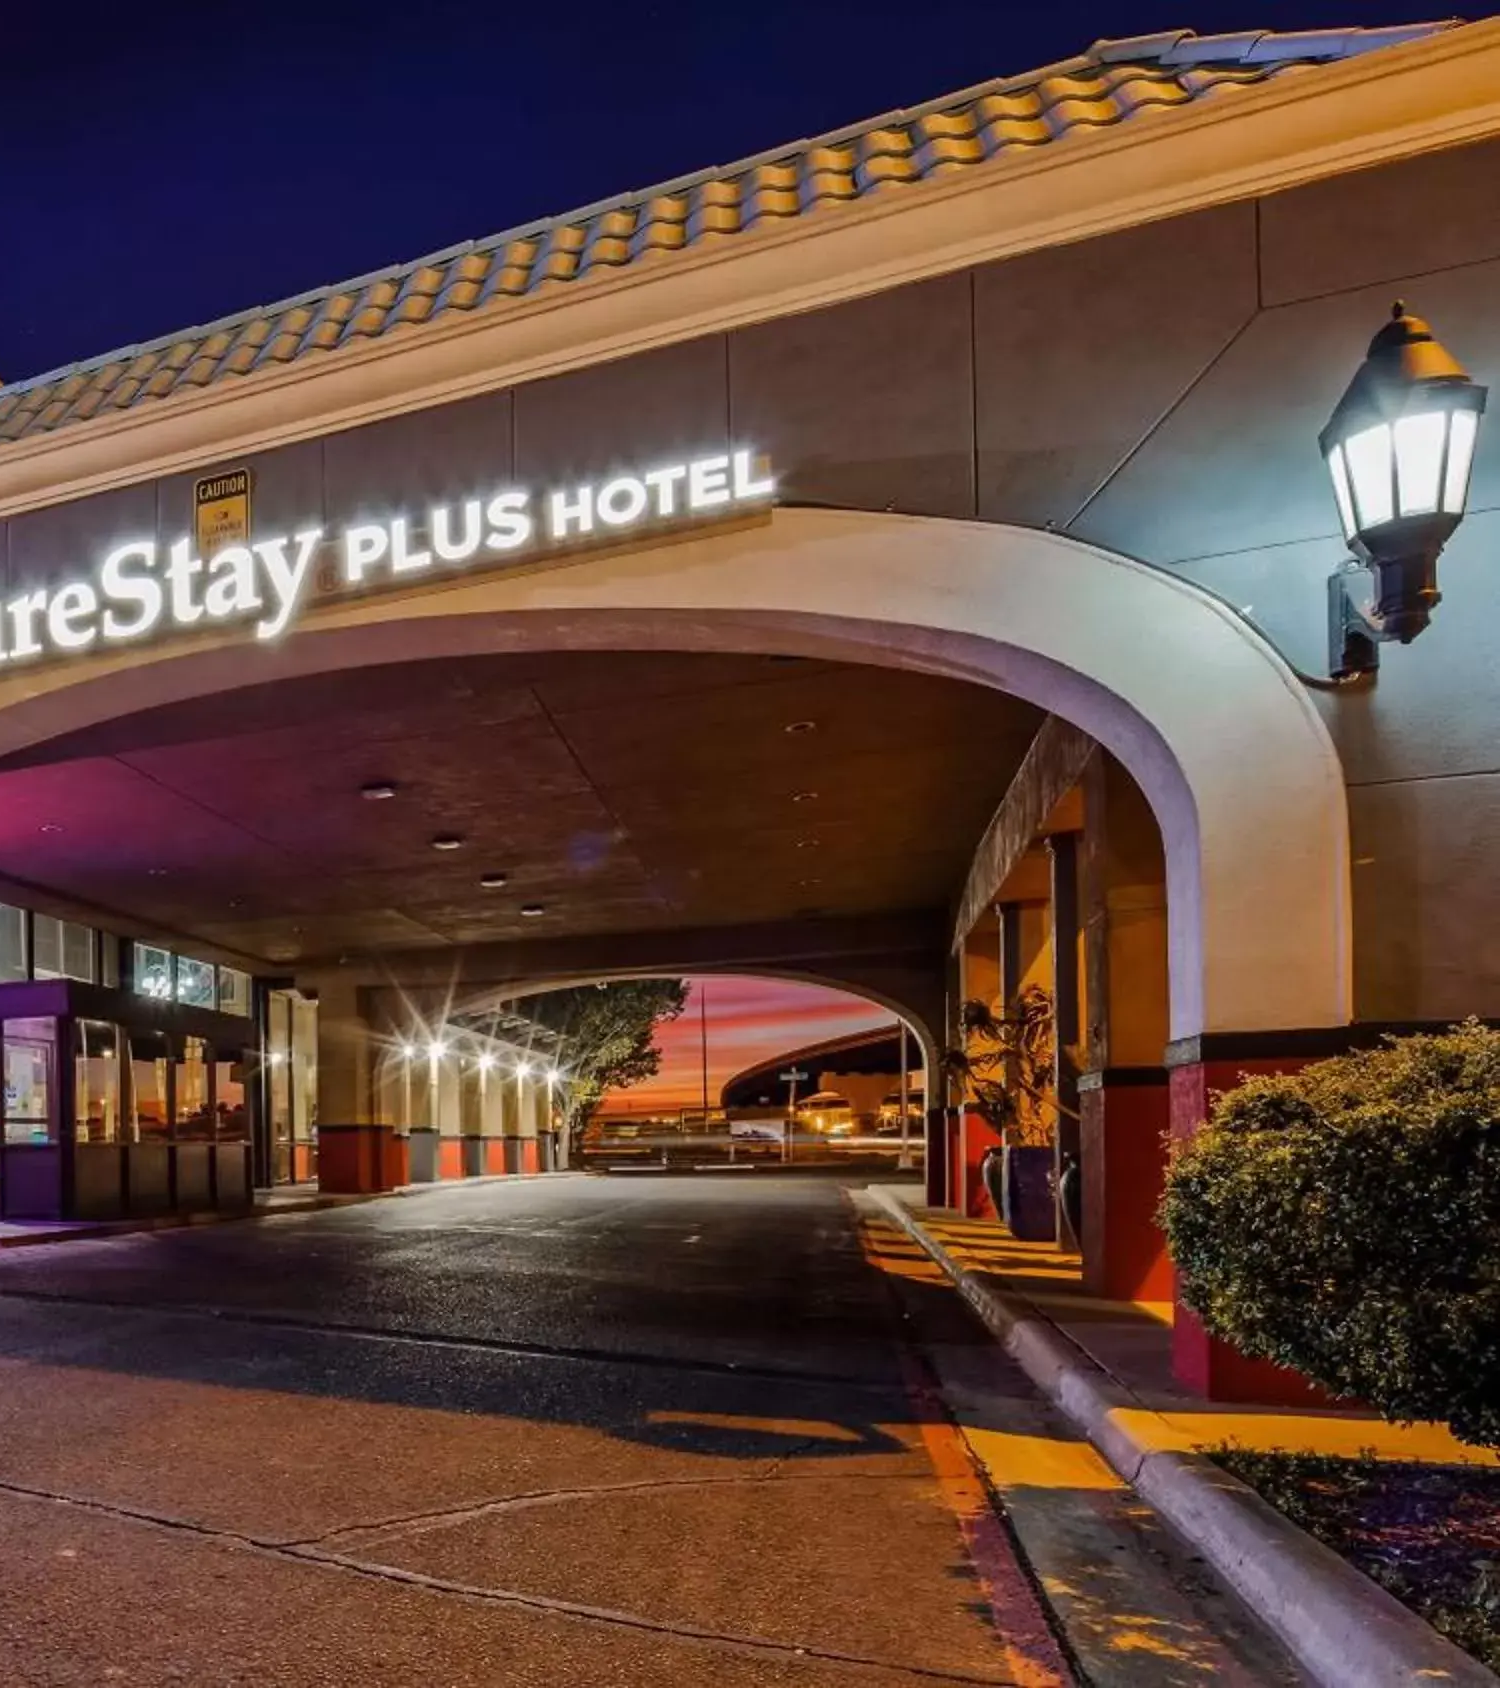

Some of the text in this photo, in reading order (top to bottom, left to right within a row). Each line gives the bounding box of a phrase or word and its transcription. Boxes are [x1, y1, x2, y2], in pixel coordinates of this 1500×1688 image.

[199, 476, 246, 501] CAUTION
[346, 491, 531, 582] PLUS
[551, 450, 774, 538] HOTEL
